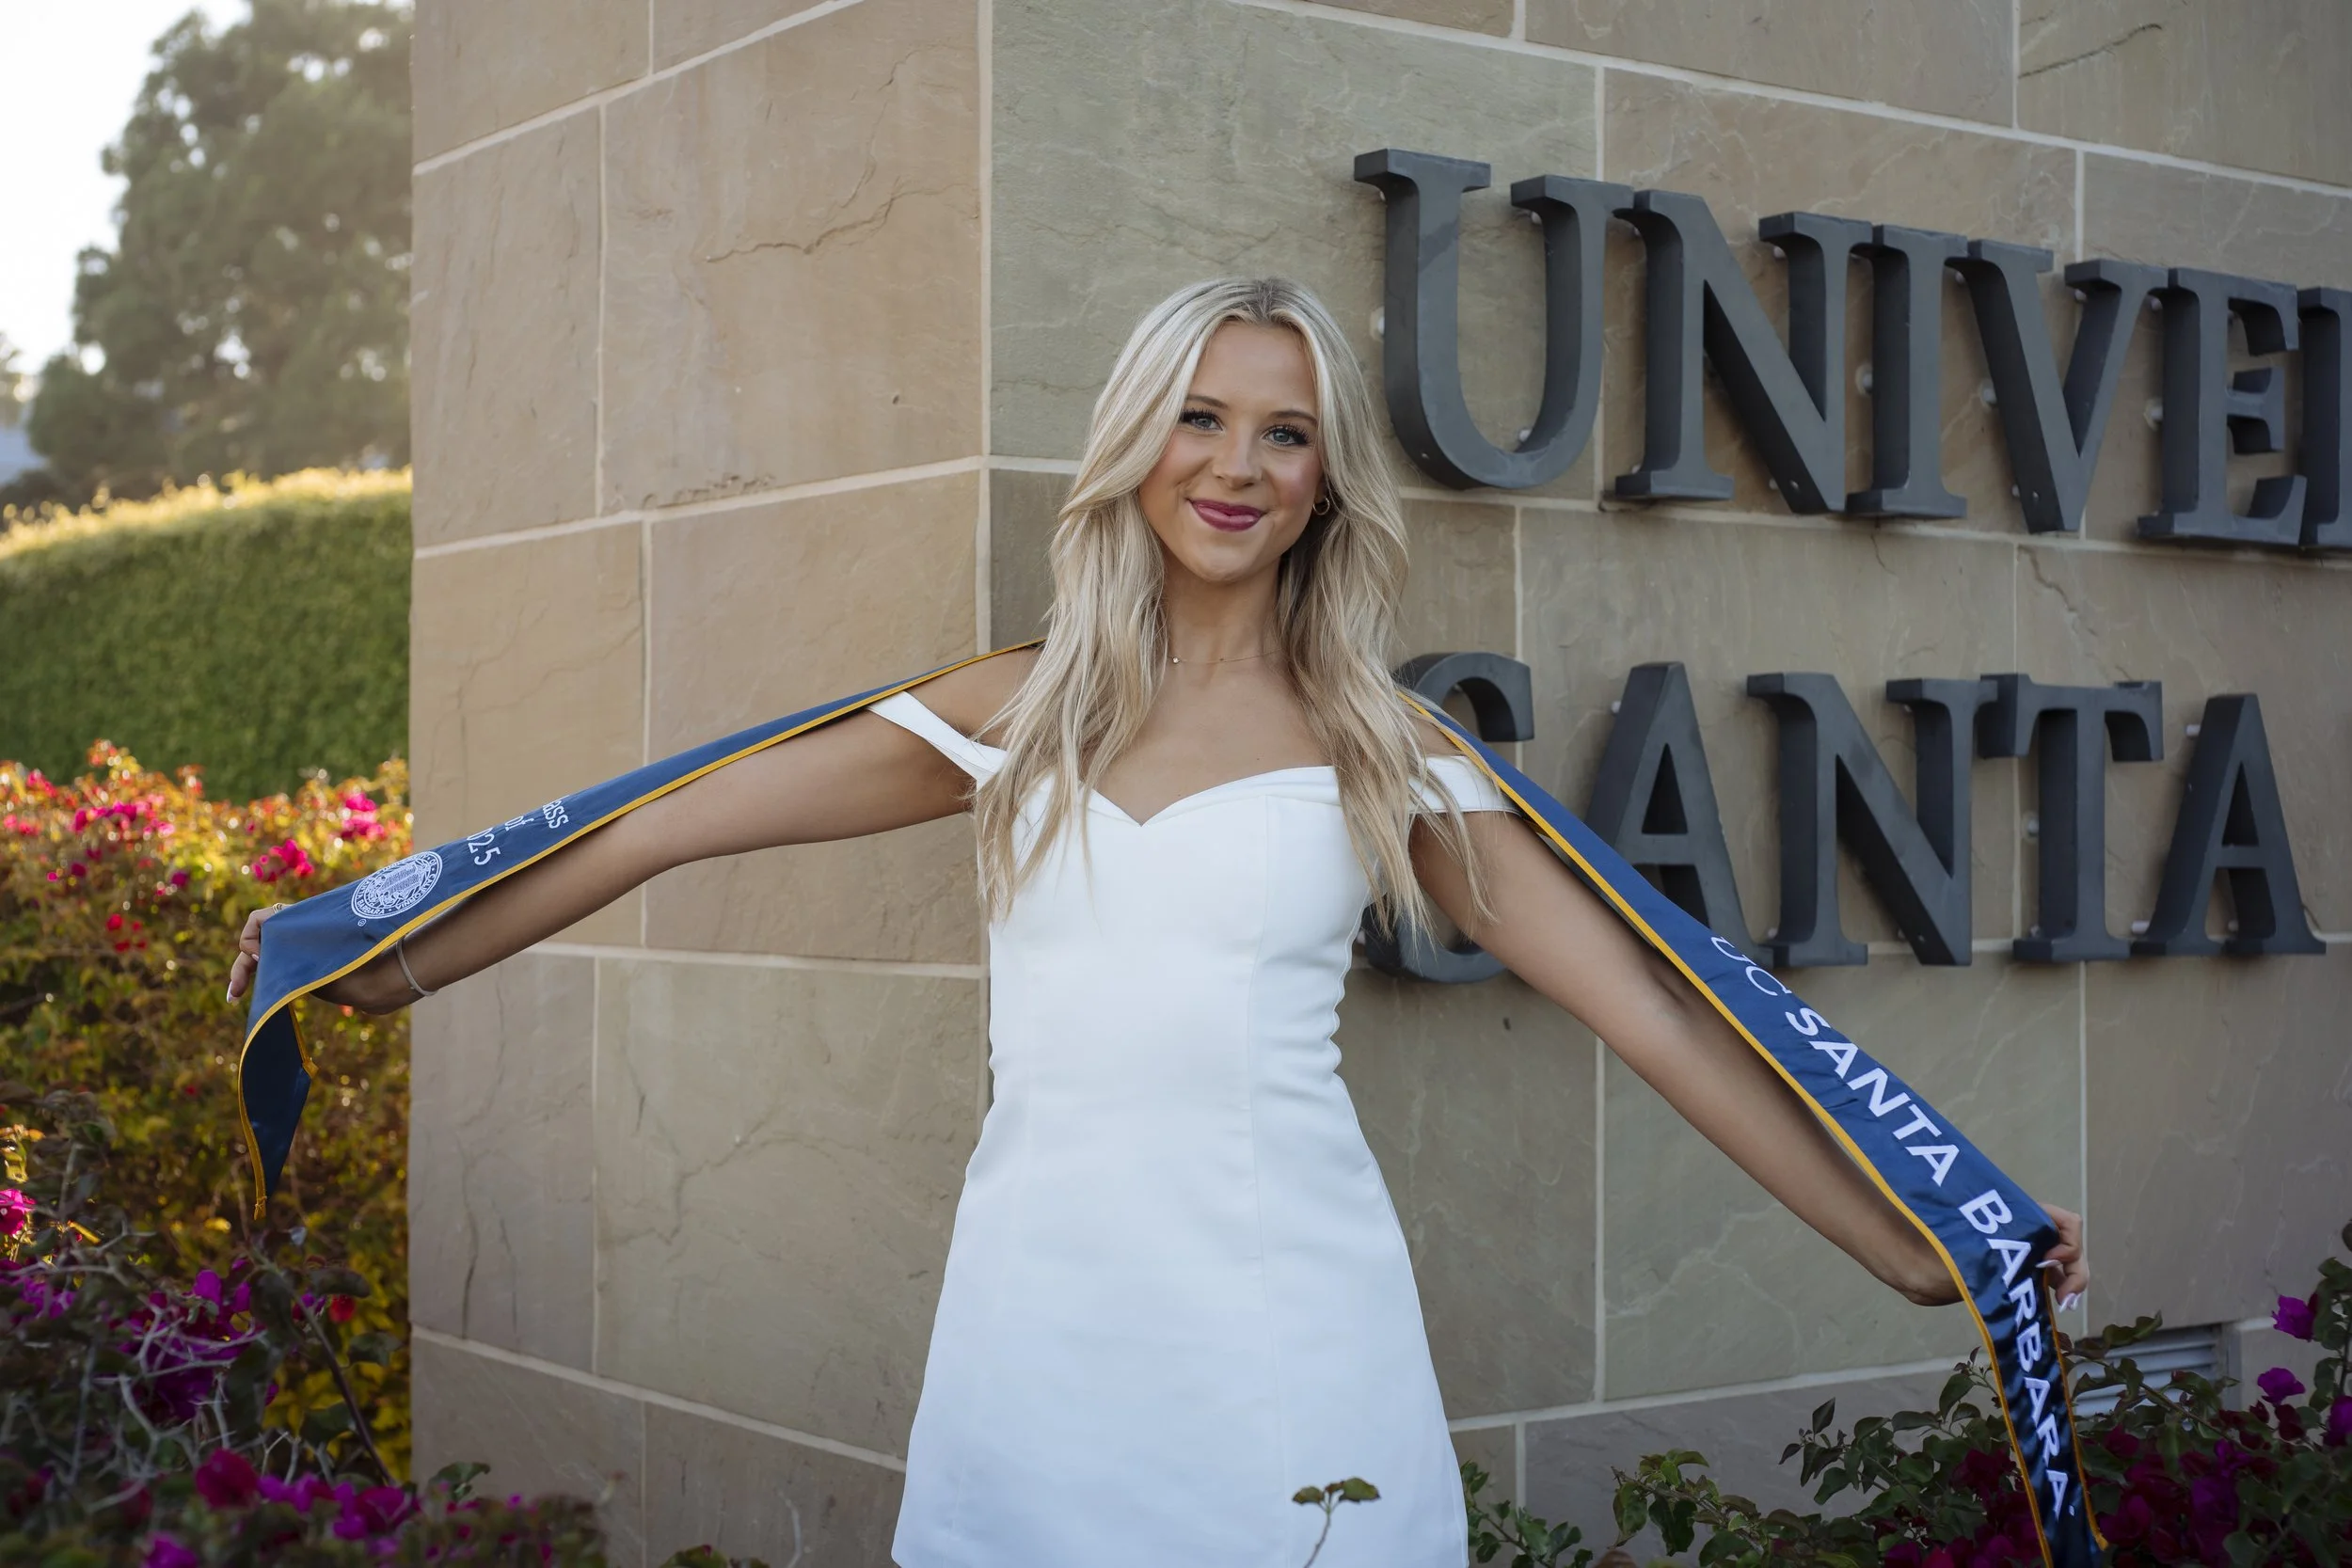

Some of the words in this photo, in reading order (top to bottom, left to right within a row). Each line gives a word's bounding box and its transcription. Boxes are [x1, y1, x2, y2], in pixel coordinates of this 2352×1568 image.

[1354, 149, 2352, 549] UNIVE
[543, 795, 569, 829] ass
[467, 828, 501, 865] 025
[357, 898, 385, 915] BARBARA
[1711, 937, 1792, 996] UC
[1786, 1007, 1960, 1187] SANTA
[1959, 1189, 2068, 1522] BARBARA
